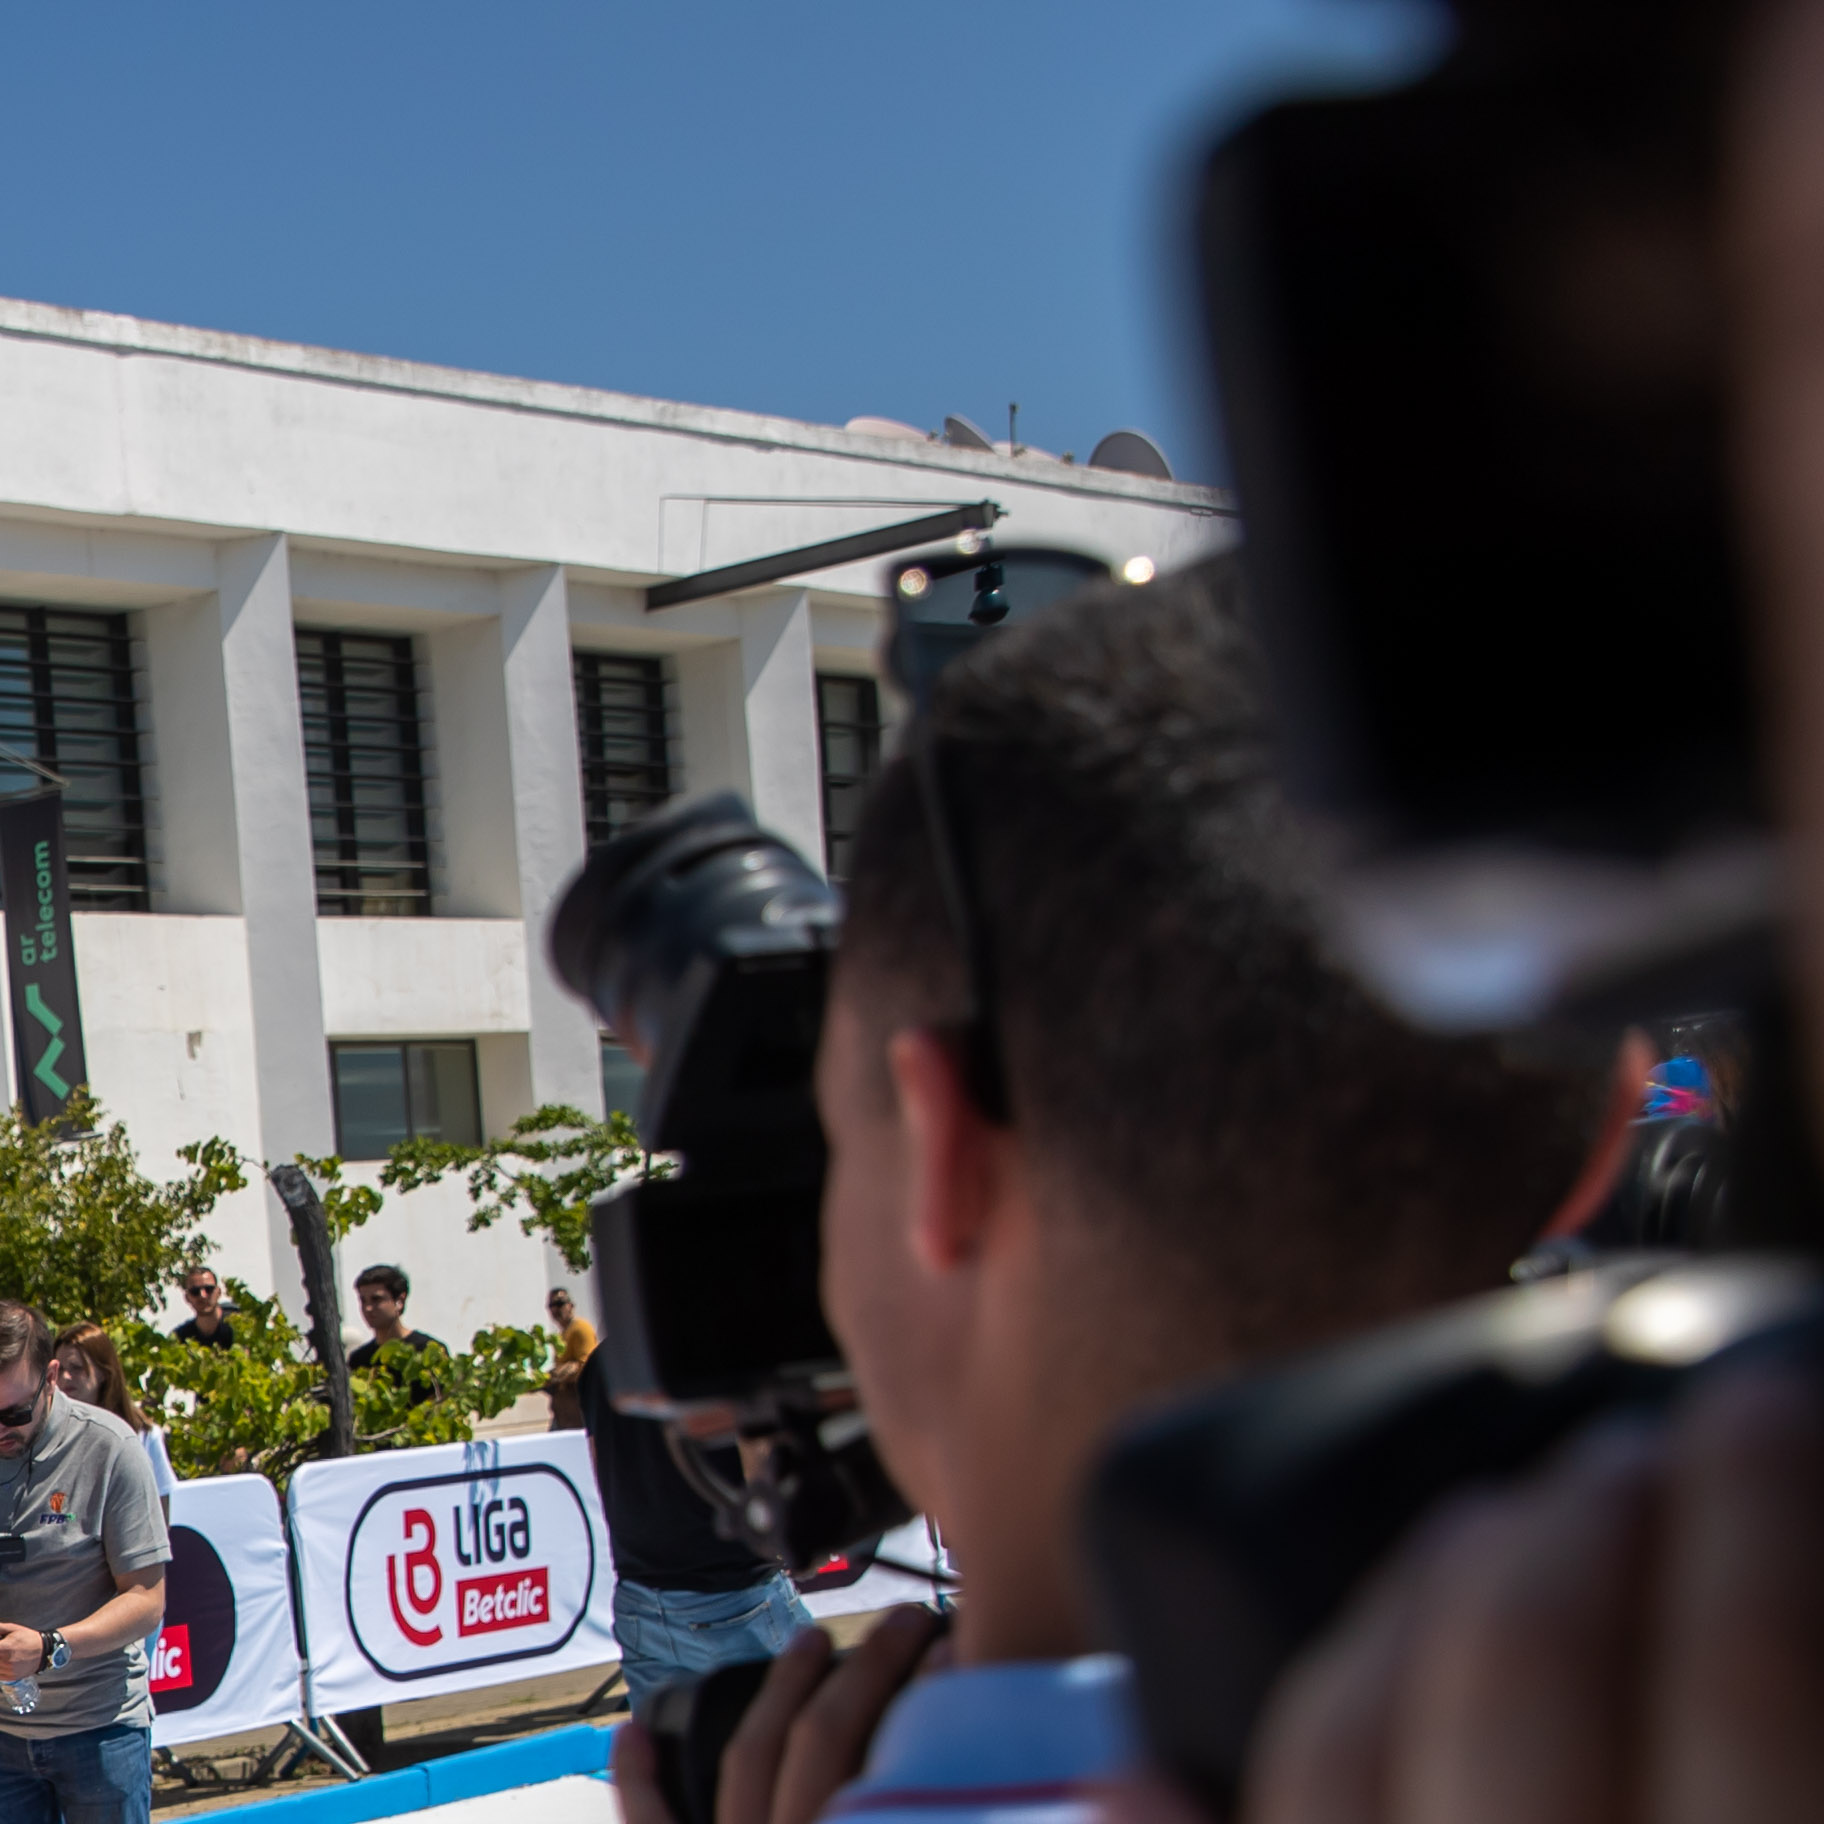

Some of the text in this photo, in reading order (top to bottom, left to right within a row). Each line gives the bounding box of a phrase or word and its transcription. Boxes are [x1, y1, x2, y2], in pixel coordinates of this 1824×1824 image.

[34, 840, 58, 964] telecom
[21, 934, 37, 967] ar
[463, 1578, 545, 1627] Betclic
